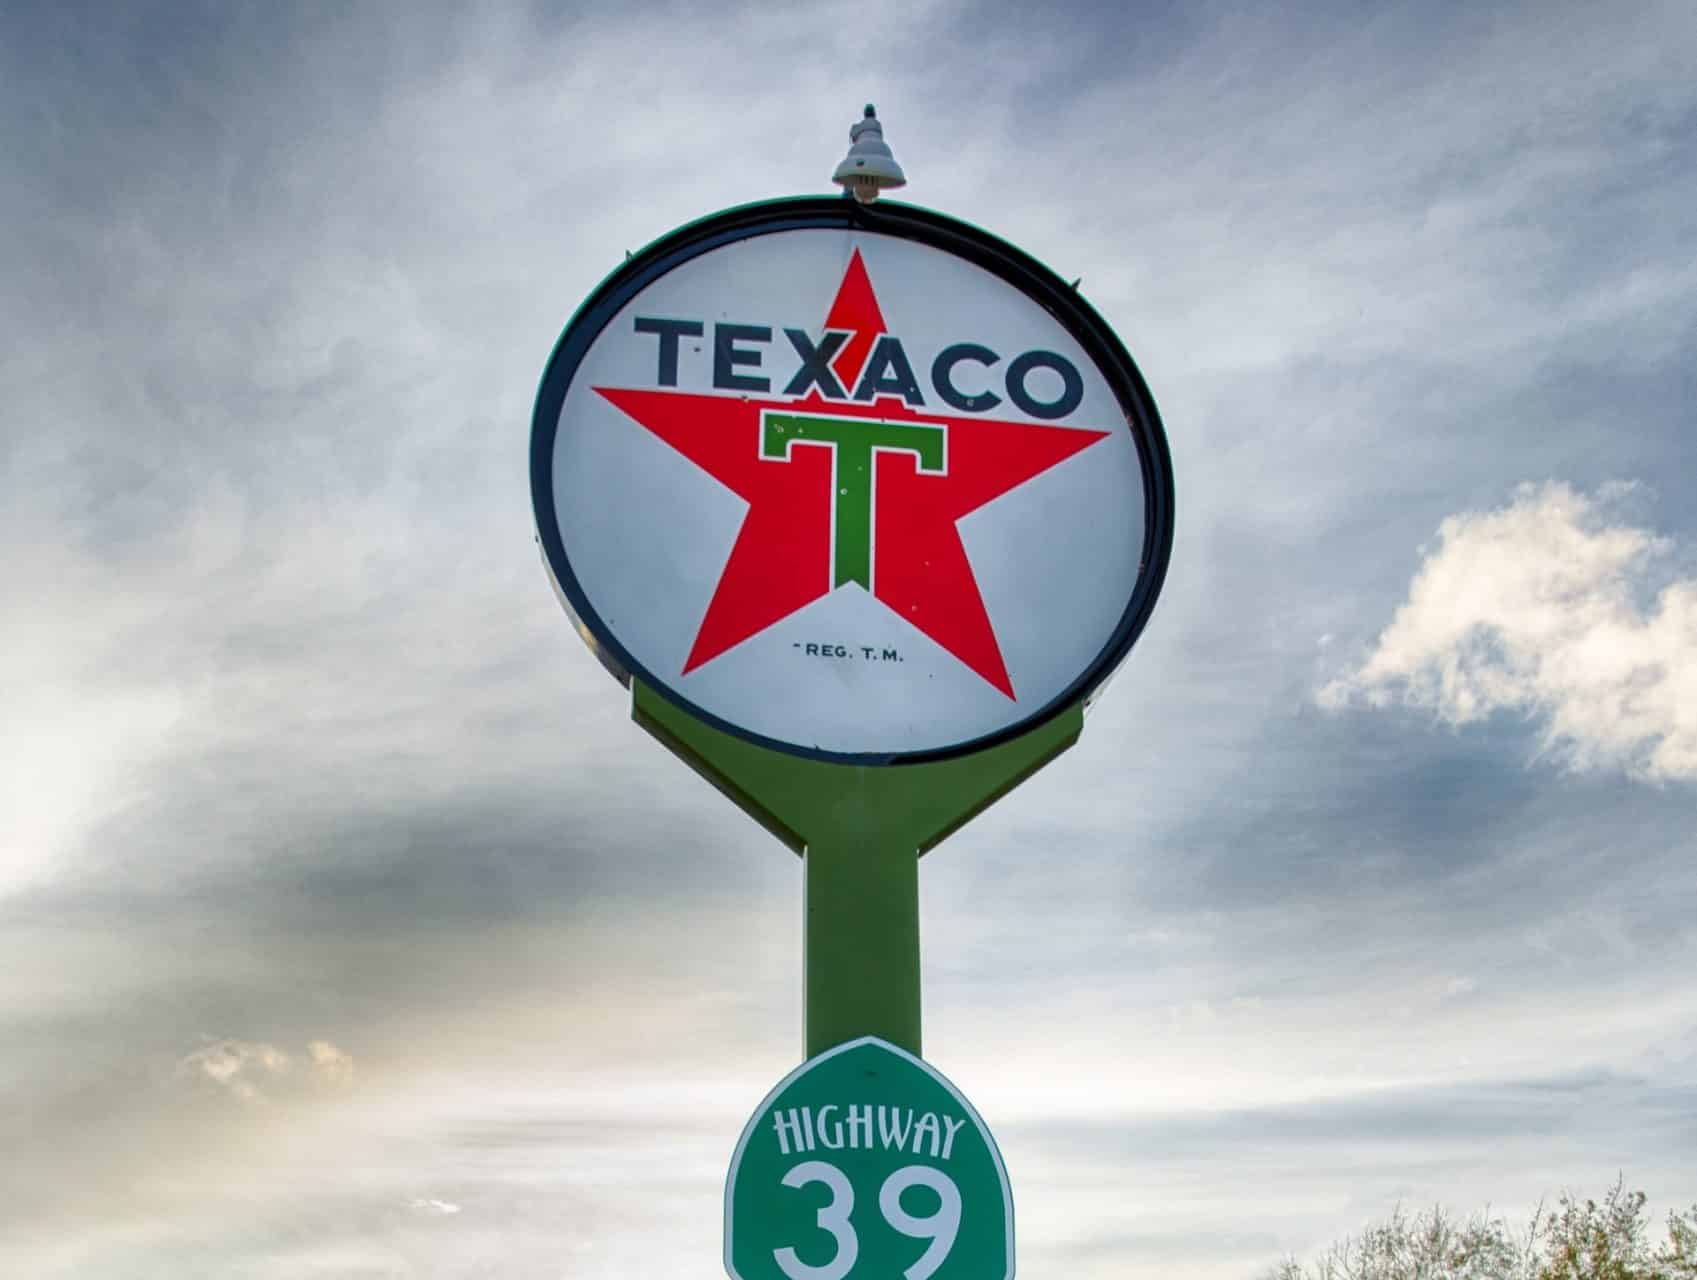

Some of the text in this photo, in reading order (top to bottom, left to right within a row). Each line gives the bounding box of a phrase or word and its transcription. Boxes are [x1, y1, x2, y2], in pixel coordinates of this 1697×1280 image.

[634, 316, 1084, 419] TEXACO
[760, 410, 947, 592] T
[773, 1105, 967, 1159] HIGHWAY
